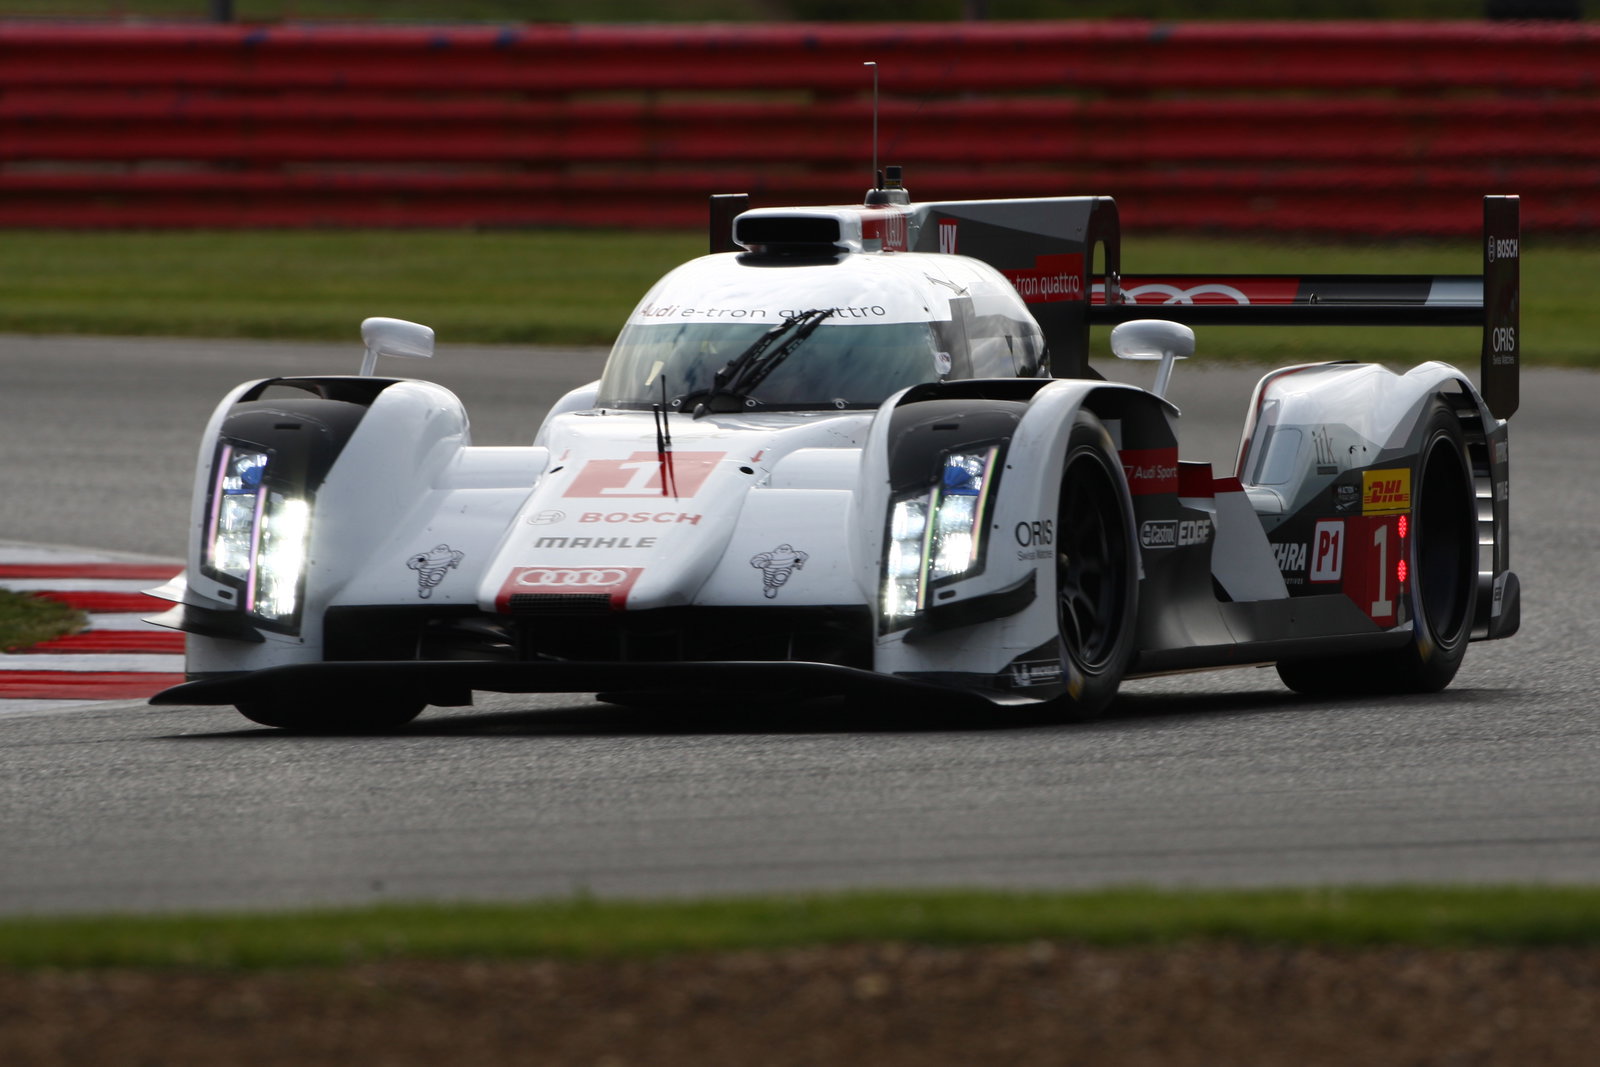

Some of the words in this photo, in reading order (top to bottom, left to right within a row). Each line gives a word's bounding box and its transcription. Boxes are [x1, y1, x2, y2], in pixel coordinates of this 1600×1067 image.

[1497, 239, 1518, 258] BOSCH
[1008, 274, 1038, 295] -tron
[1040, 272, 1080, 300] quattro
[681, 306, 767, 318] e-tron
[778, 305, 887, 321] qattro
[1492, 327, 1515, 352] ORIS
[599, 461, 664, 494] 1
[1134, 465, 1156, 479] Audi
[1156, 464, 1178, 481] Sport
[1371, 479, 1405, 503] DHL
[578, 511, 703, 526] BOSCH
[533, 537, 657, 549] MAHLE
[1015, 519, 1054, 548] ORIS
[1178, 519, 1211, 546] EDGE
[1316, 530, 1340, 572] P1
[1371, 524, 1393, 617] 1
